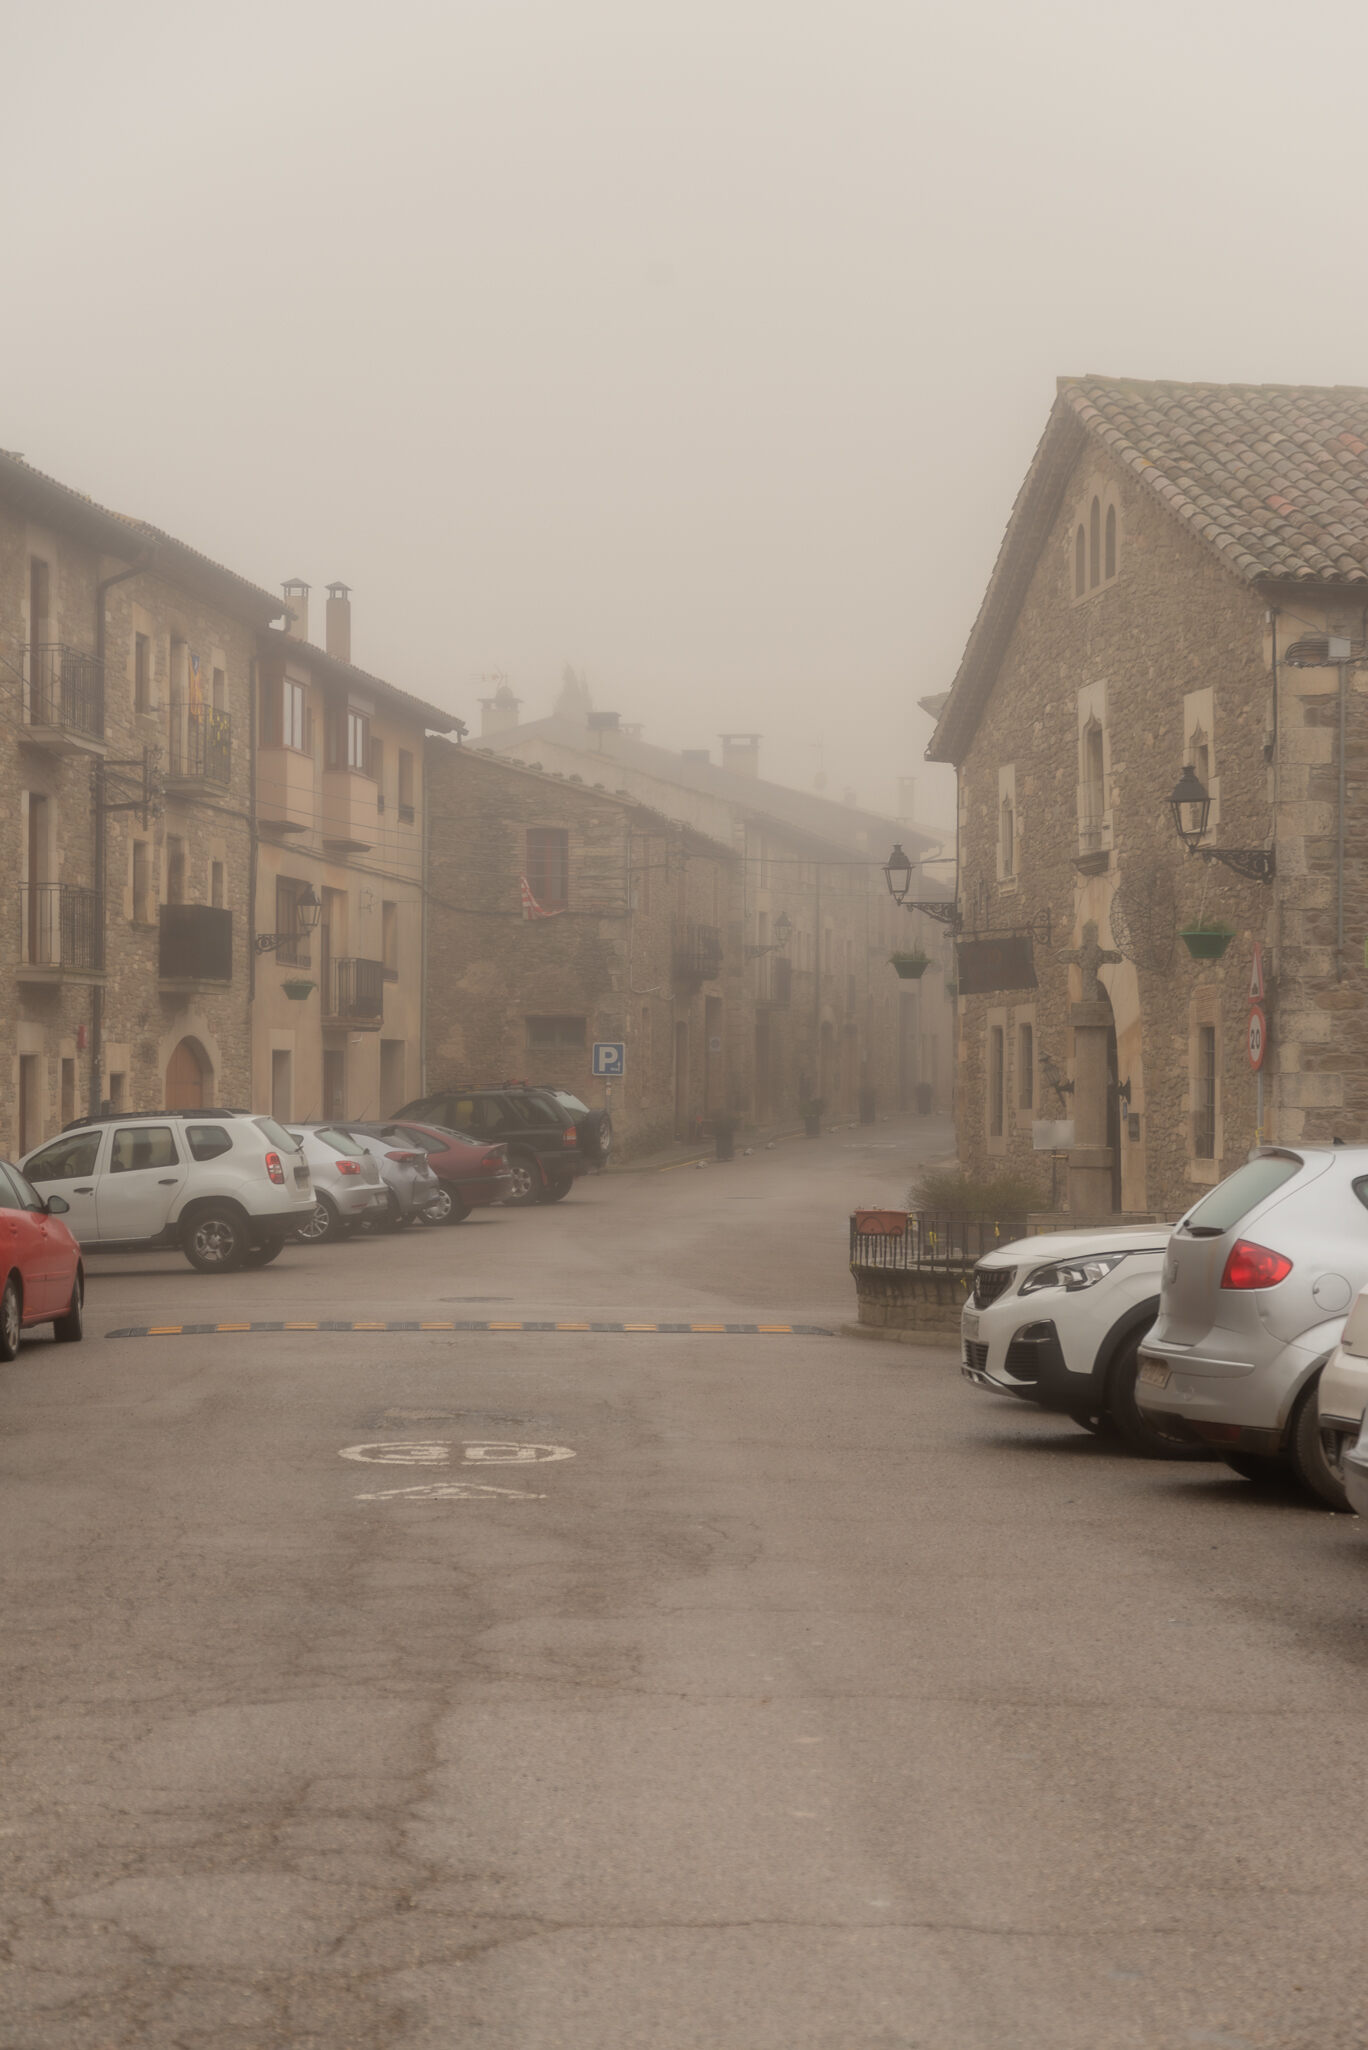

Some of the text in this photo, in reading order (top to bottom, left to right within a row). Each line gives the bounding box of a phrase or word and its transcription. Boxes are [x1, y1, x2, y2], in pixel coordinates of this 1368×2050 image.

[1250, 1029, 1261, 1050] 20
[598, 1046, 618, 1072] P
[379, 1446, 536, 1459] 30
